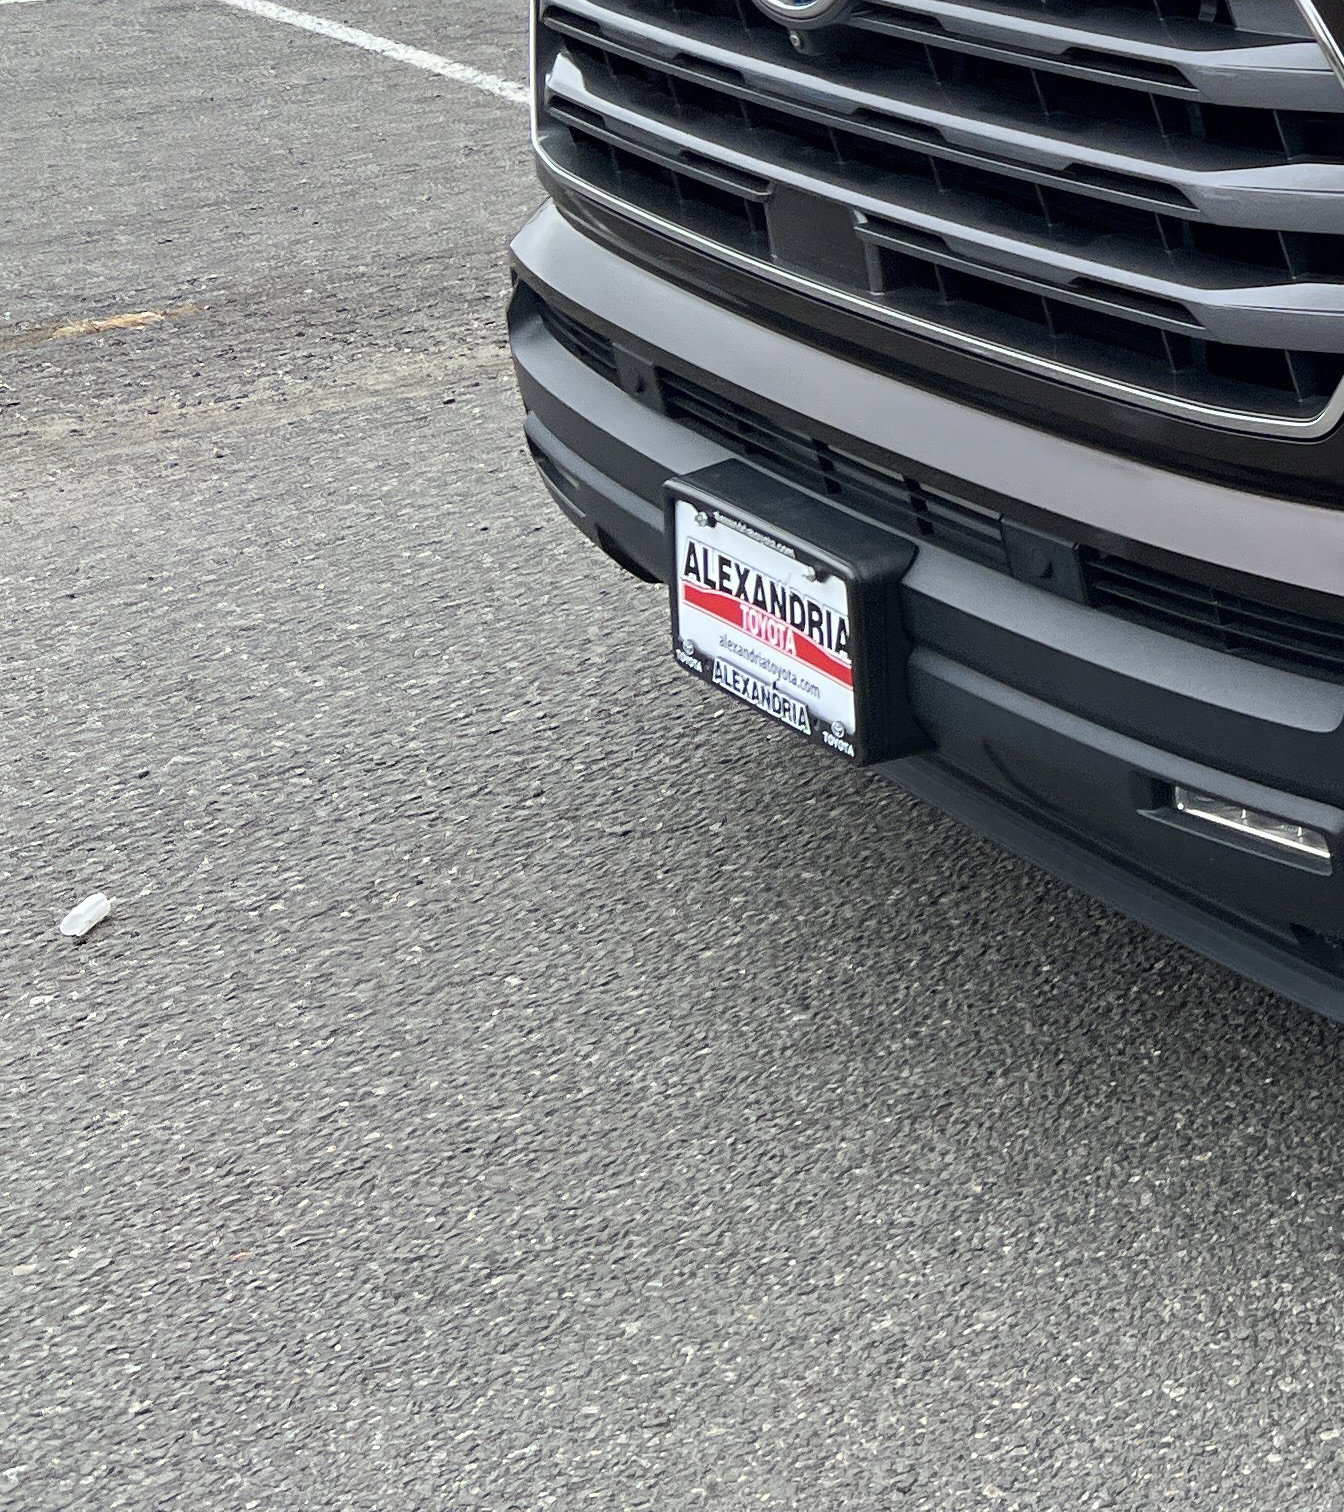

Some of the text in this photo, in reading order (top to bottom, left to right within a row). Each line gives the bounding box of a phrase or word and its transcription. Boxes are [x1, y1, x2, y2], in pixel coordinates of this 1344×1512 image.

[683, 540, 850, 656] ALEXANDRIA
[739, 603, 797, 657] TOYOTA
[713, 658, 811, 731] ALEXANDRIA
[718, 634, 821, 700] alexandriatoyota.com
